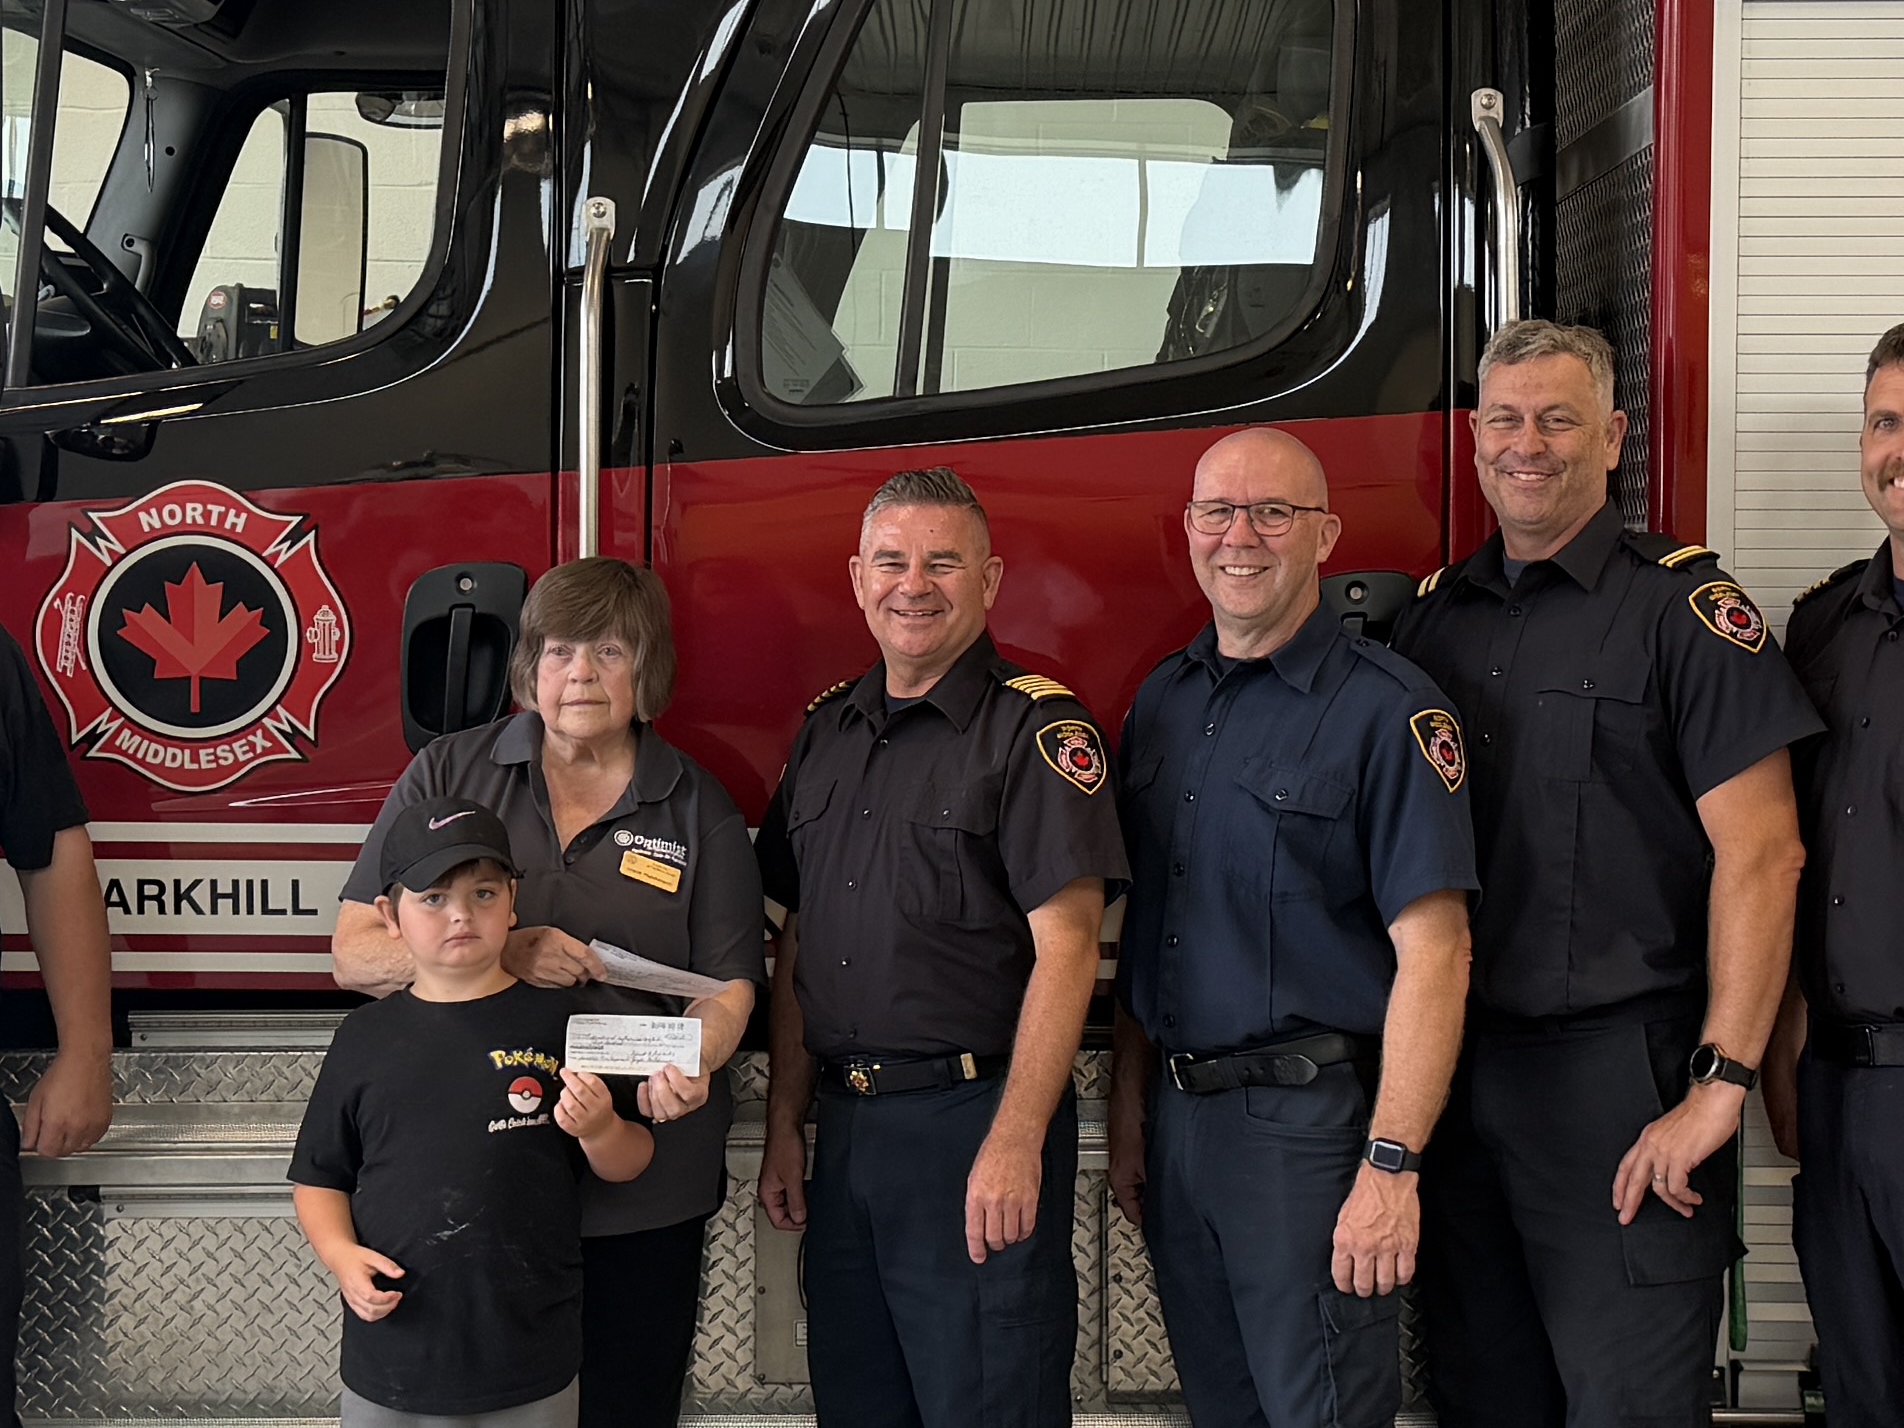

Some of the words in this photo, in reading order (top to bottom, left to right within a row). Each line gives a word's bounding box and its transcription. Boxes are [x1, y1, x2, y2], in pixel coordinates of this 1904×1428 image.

[137, 502, 248, 533] NORTH
[114, 728, 273, 770] MIDDLESEX
[103, 878, 319, 916] ARKHILL
